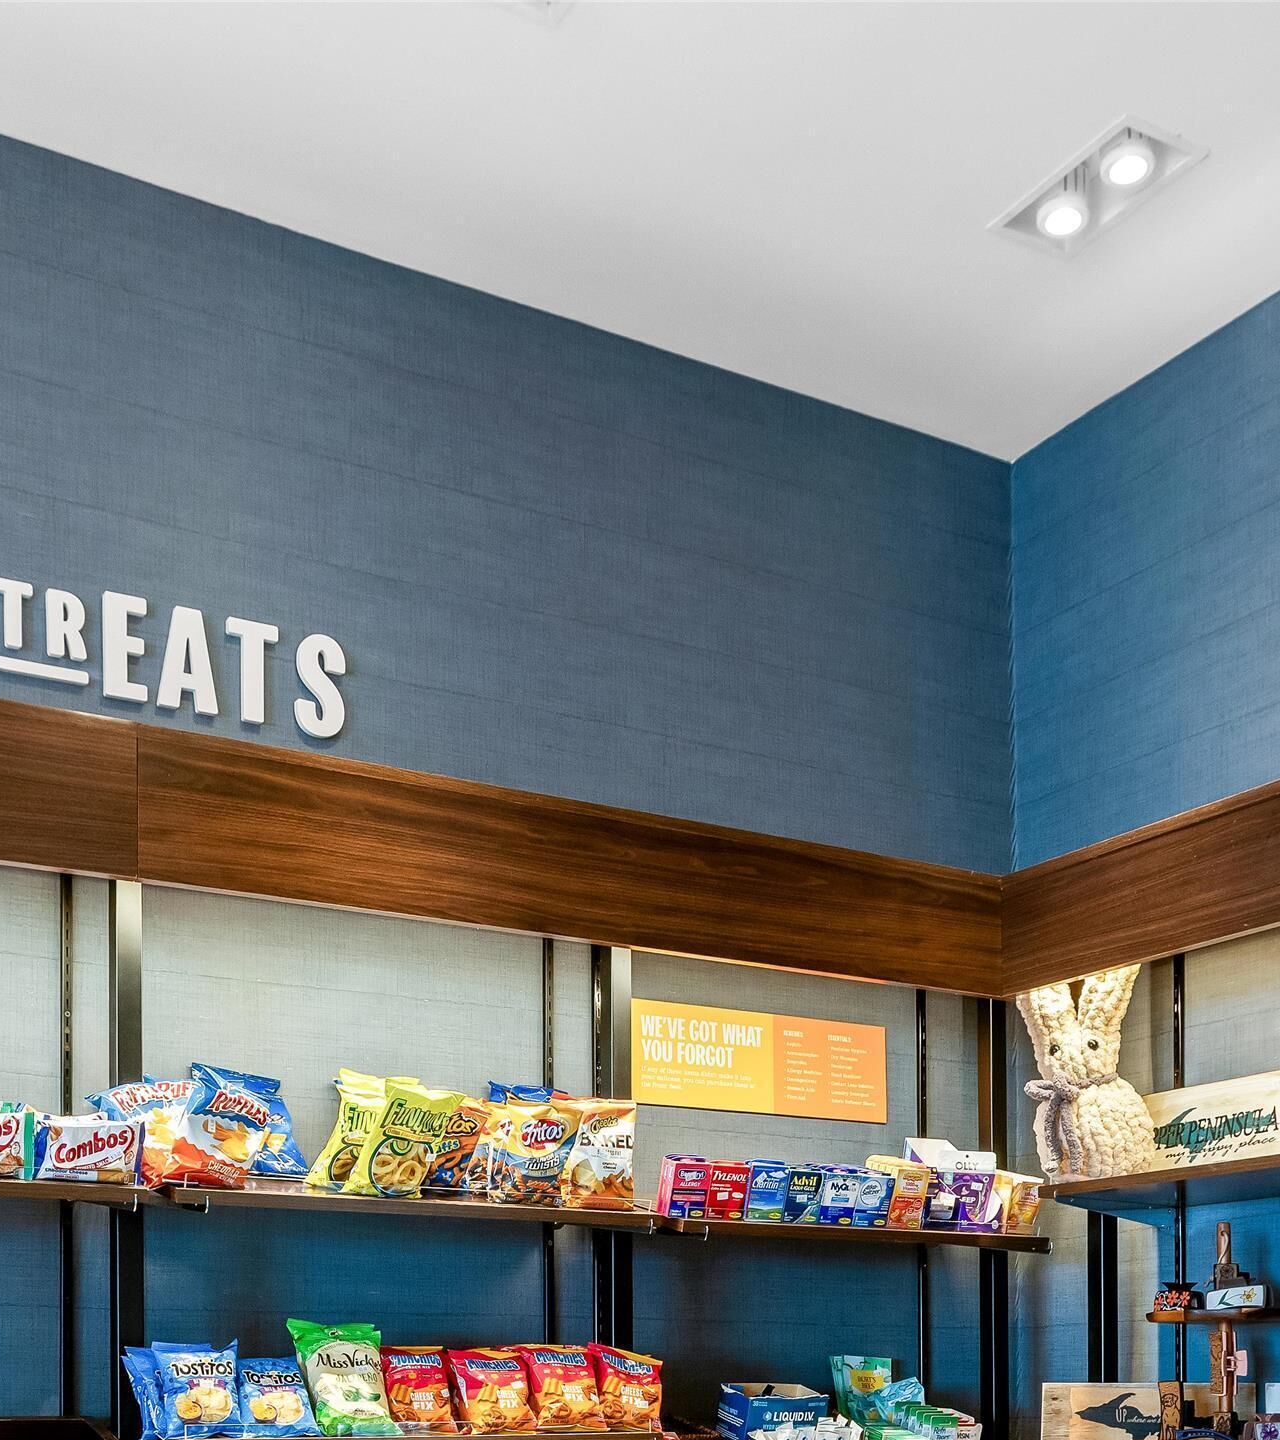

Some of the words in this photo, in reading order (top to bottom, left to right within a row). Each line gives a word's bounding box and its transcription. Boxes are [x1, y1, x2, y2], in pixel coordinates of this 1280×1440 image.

[640, 1014, 686, 1041] WE'VE
[688, 1019, 719, 1044] GOT
[721, 1022, 764, 1049] WHAT
[641, 1038, 674, 1064] YOU
[676, 1041, 735, 1070] FORGOT
[207, 1090, 271, 1128] RUFFLES
[590, 1116, 619, 1136] Cheetos
[1187, 1104, 1280, 1145] PENINSULA
[55, 1125, 131, 1165] Combos
[1164, 1150, 1186, 1166] my
[208, 1160, 241, 1180] CHEDDAR
[954, 1161, 979, 1172] OLLY
[712, 1170, 748, 1183] TYLENOL
[752, 1178, 780, 1190] Claritin
[790, 1175, 817, 1187] Advil
[389, 1353, 442, 1369] MUNCHIES
[467, 1358, 519, 1371] MUNCHIES
[534, 1351, 587, 1368] MUNCHIES
[413, 1400, 434, 1411] FIX
[499, 1399, 519, 1409] FIX
[564, 1393, 585, 1403] FIX
[1114, 1408, 1128, 1424] UP
